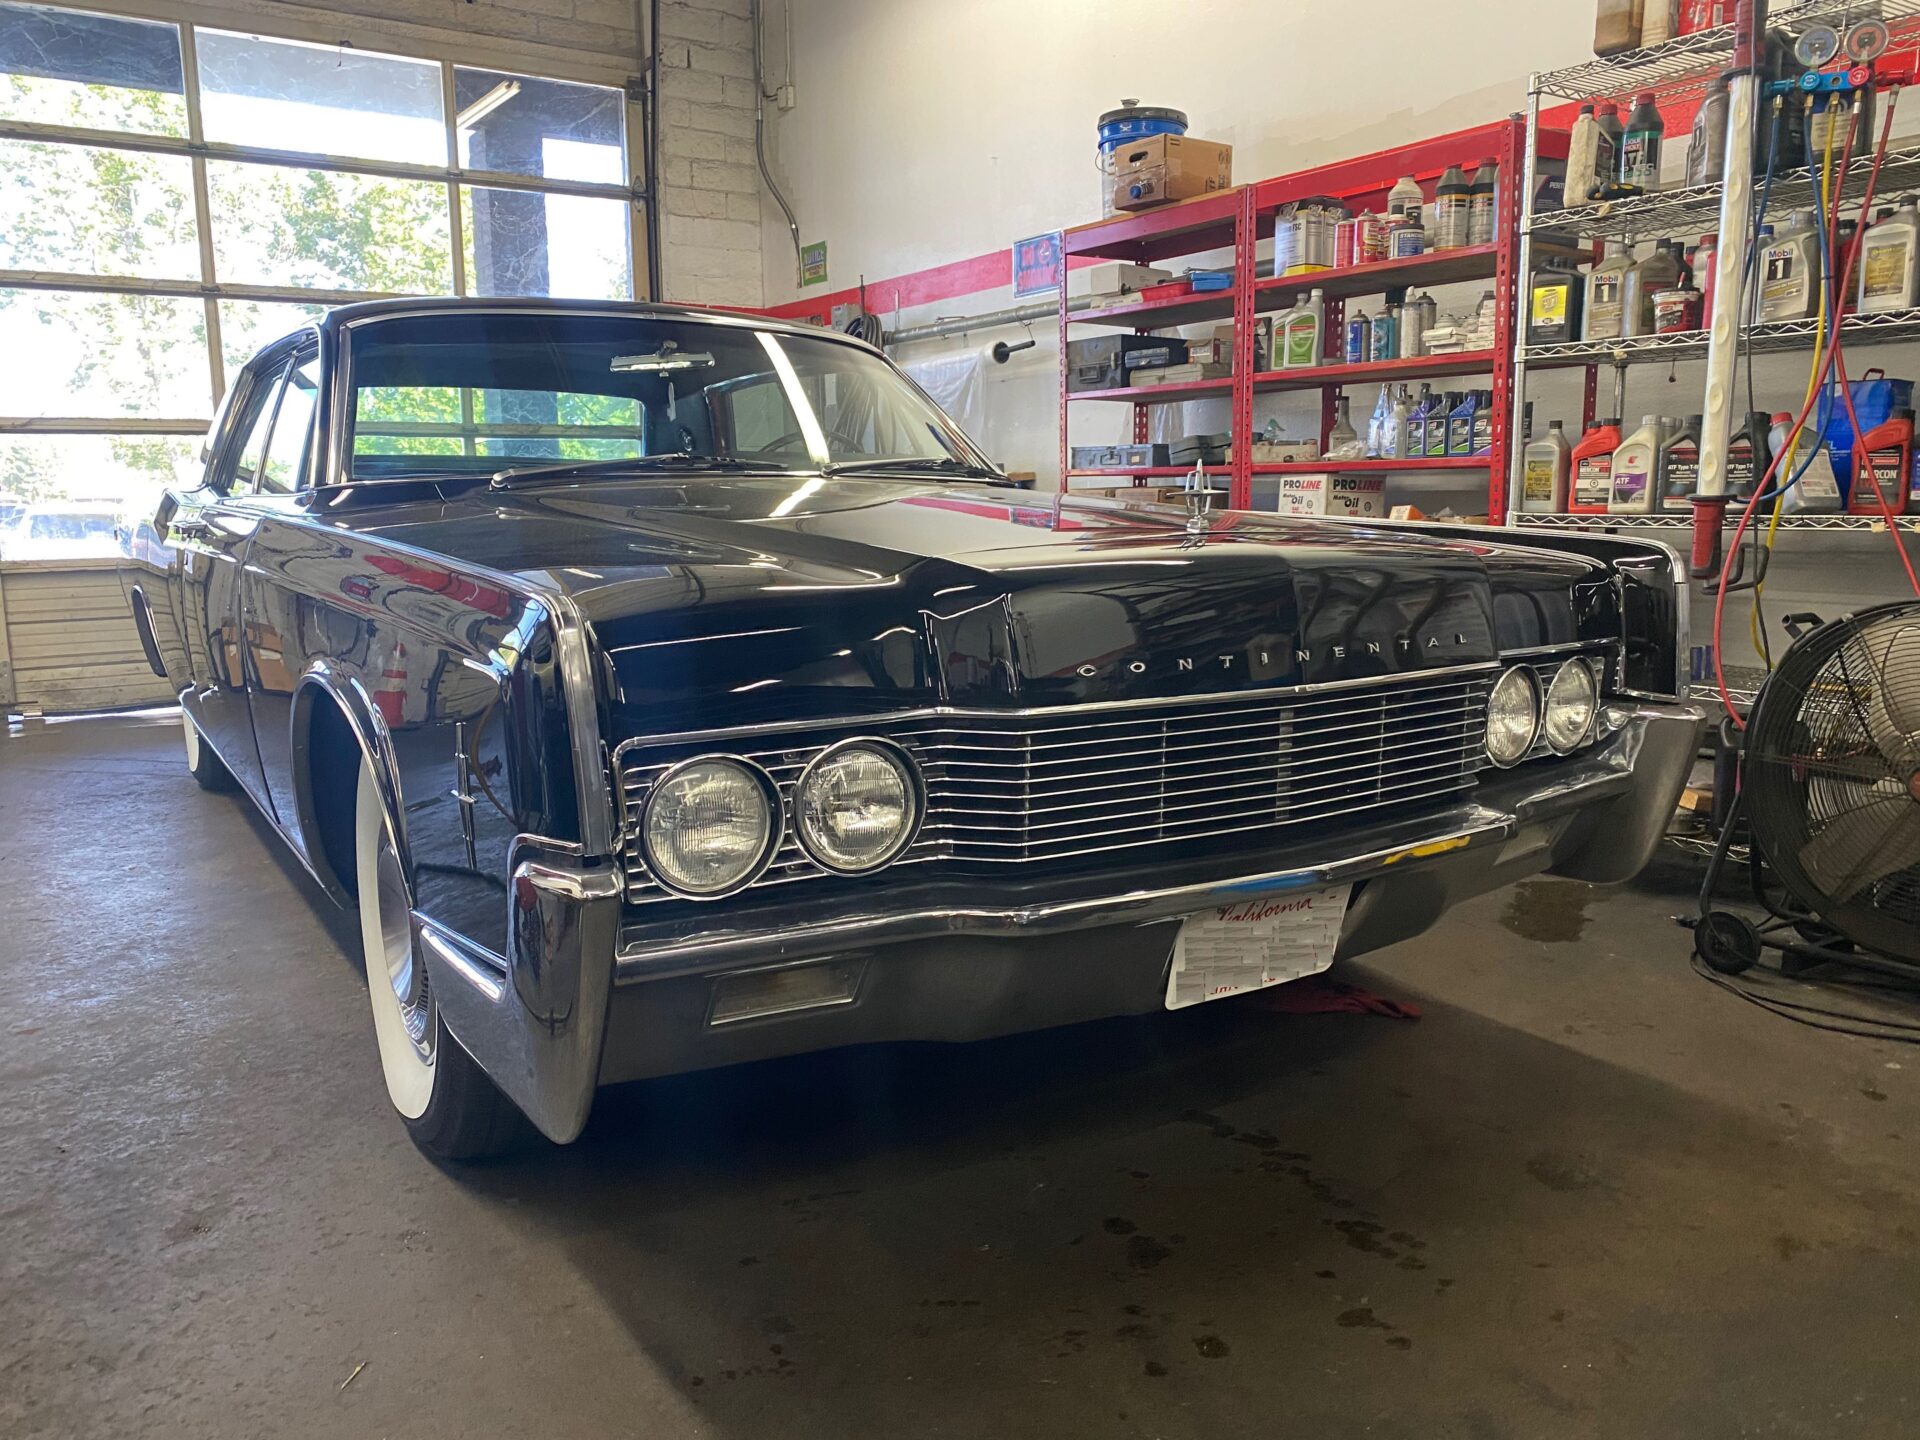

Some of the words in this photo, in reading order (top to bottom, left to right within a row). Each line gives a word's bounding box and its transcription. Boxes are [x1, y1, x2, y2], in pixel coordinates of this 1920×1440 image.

[1768, 248, 1794, 259] Mobil
[1775, 259, 1785, 280] 1
[1594, 275, 1618, 284] Mobil
[1600, 284, 1610, 302] 1
[1860, 469, 1898, 479] MRCON
[1283, 479, 1322, 490] PROLINE
[1332, 478, 1384, 491] PROLINE
[1615, 476, 1631, 485] ATF
[1077, 633, 1468, 678] CONTINENTAL
